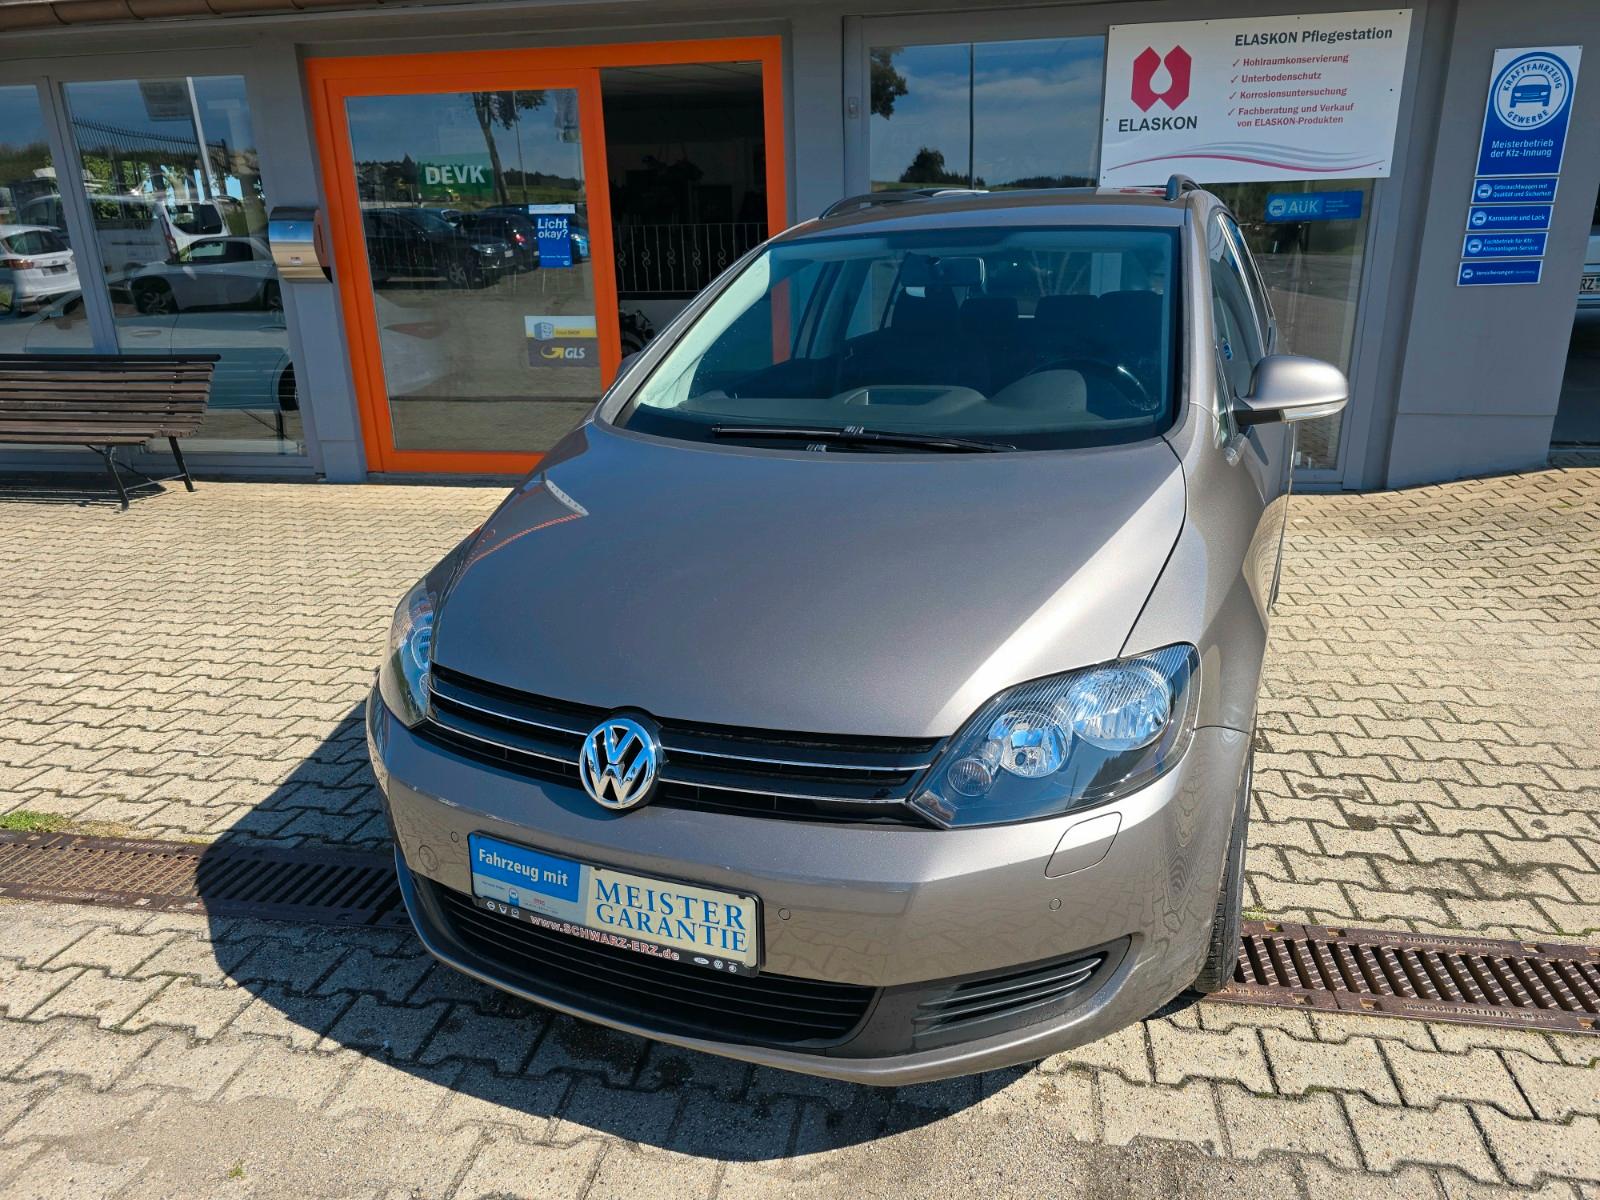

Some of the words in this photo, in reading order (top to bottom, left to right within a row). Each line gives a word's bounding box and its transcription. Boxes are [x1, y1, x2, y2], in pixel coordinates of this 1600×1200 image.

[1234, 31, 1298, 47] ELASKON
[1301, 26, 1393, 45] Pflegestation
[1242, 53, 1350, 67] Hohlraumkonservierung
[1241, 70, 1322, 83] Unterbodenschutz
[1502, 62, 1563, 92] KRAFTFAHRZEUG
[1239, 86, 1348, 100] Korrosionsuntersuchung
[1238, 104, 1299, 117] Fachberatung
[1300, 103, 1318, 114] und
[1319, 102, 1354, 113] Verkauf
[1507, 109, 1550, 124] GEWERBE
[1118, 115, 1198, 133] ELASKON
[1236, 118, 1252, 127] von
[1254, 114, 1344, 127] ELASKON-Produkten
[1491, 138, 1555, 149] Meisterbetrieb
[1490, 148, 1504, 158] der
[1506, 148, 1553, 158] Kfz-Innung
[425, 164, 486, 186] DEVK
[537, 217, 568, 230] Licht
[538, 228, 569, 240] okay?
[565, 347, 586, 359] GLS
[579, 719, 657, 809] VW
[478, 848, 540, 883] Fahrzeug
[543, 869, 569, 888] mit
[595, 878, 746, 930] MEISTER
[596, 904, 750, 953] GARANTIE
[530, 914, 680, 962] www.SCHWARZ-ERZ.de
